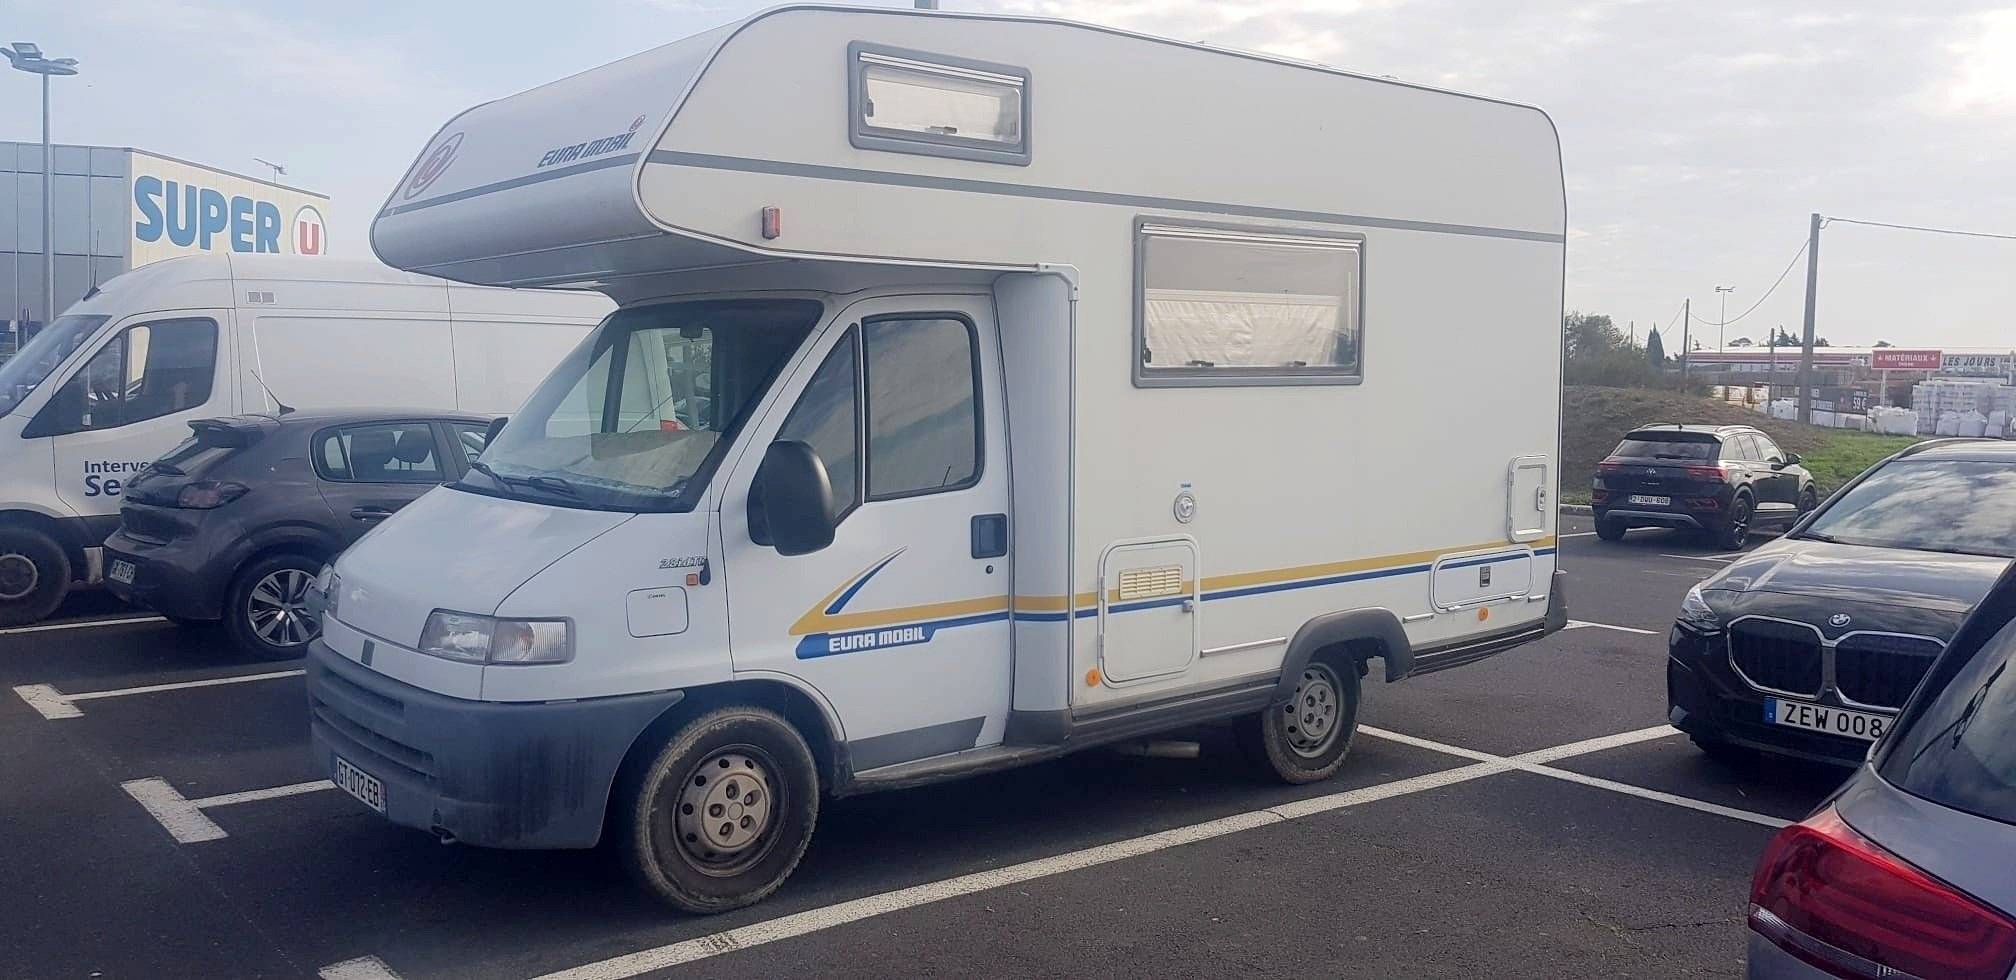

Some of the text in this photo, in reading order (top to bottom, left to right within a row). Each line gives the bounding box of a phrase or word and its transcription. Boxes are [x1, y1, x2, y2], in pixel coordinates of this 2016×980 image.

[537, 132, 637, 168] EURA MOBIL
[134, 175, 319, 255] SUPER U
[1884, 352, 1928, 361] MATÉRIAUX
[1942, 357, 1959, 366] LES
[1963, 357, 1995, 367] JOURS
[85, 475, 121, 497] Se
[829, 626, 926, 652] EURA MOBIL
[1784, 703, 1883, 739] ZEW 008
